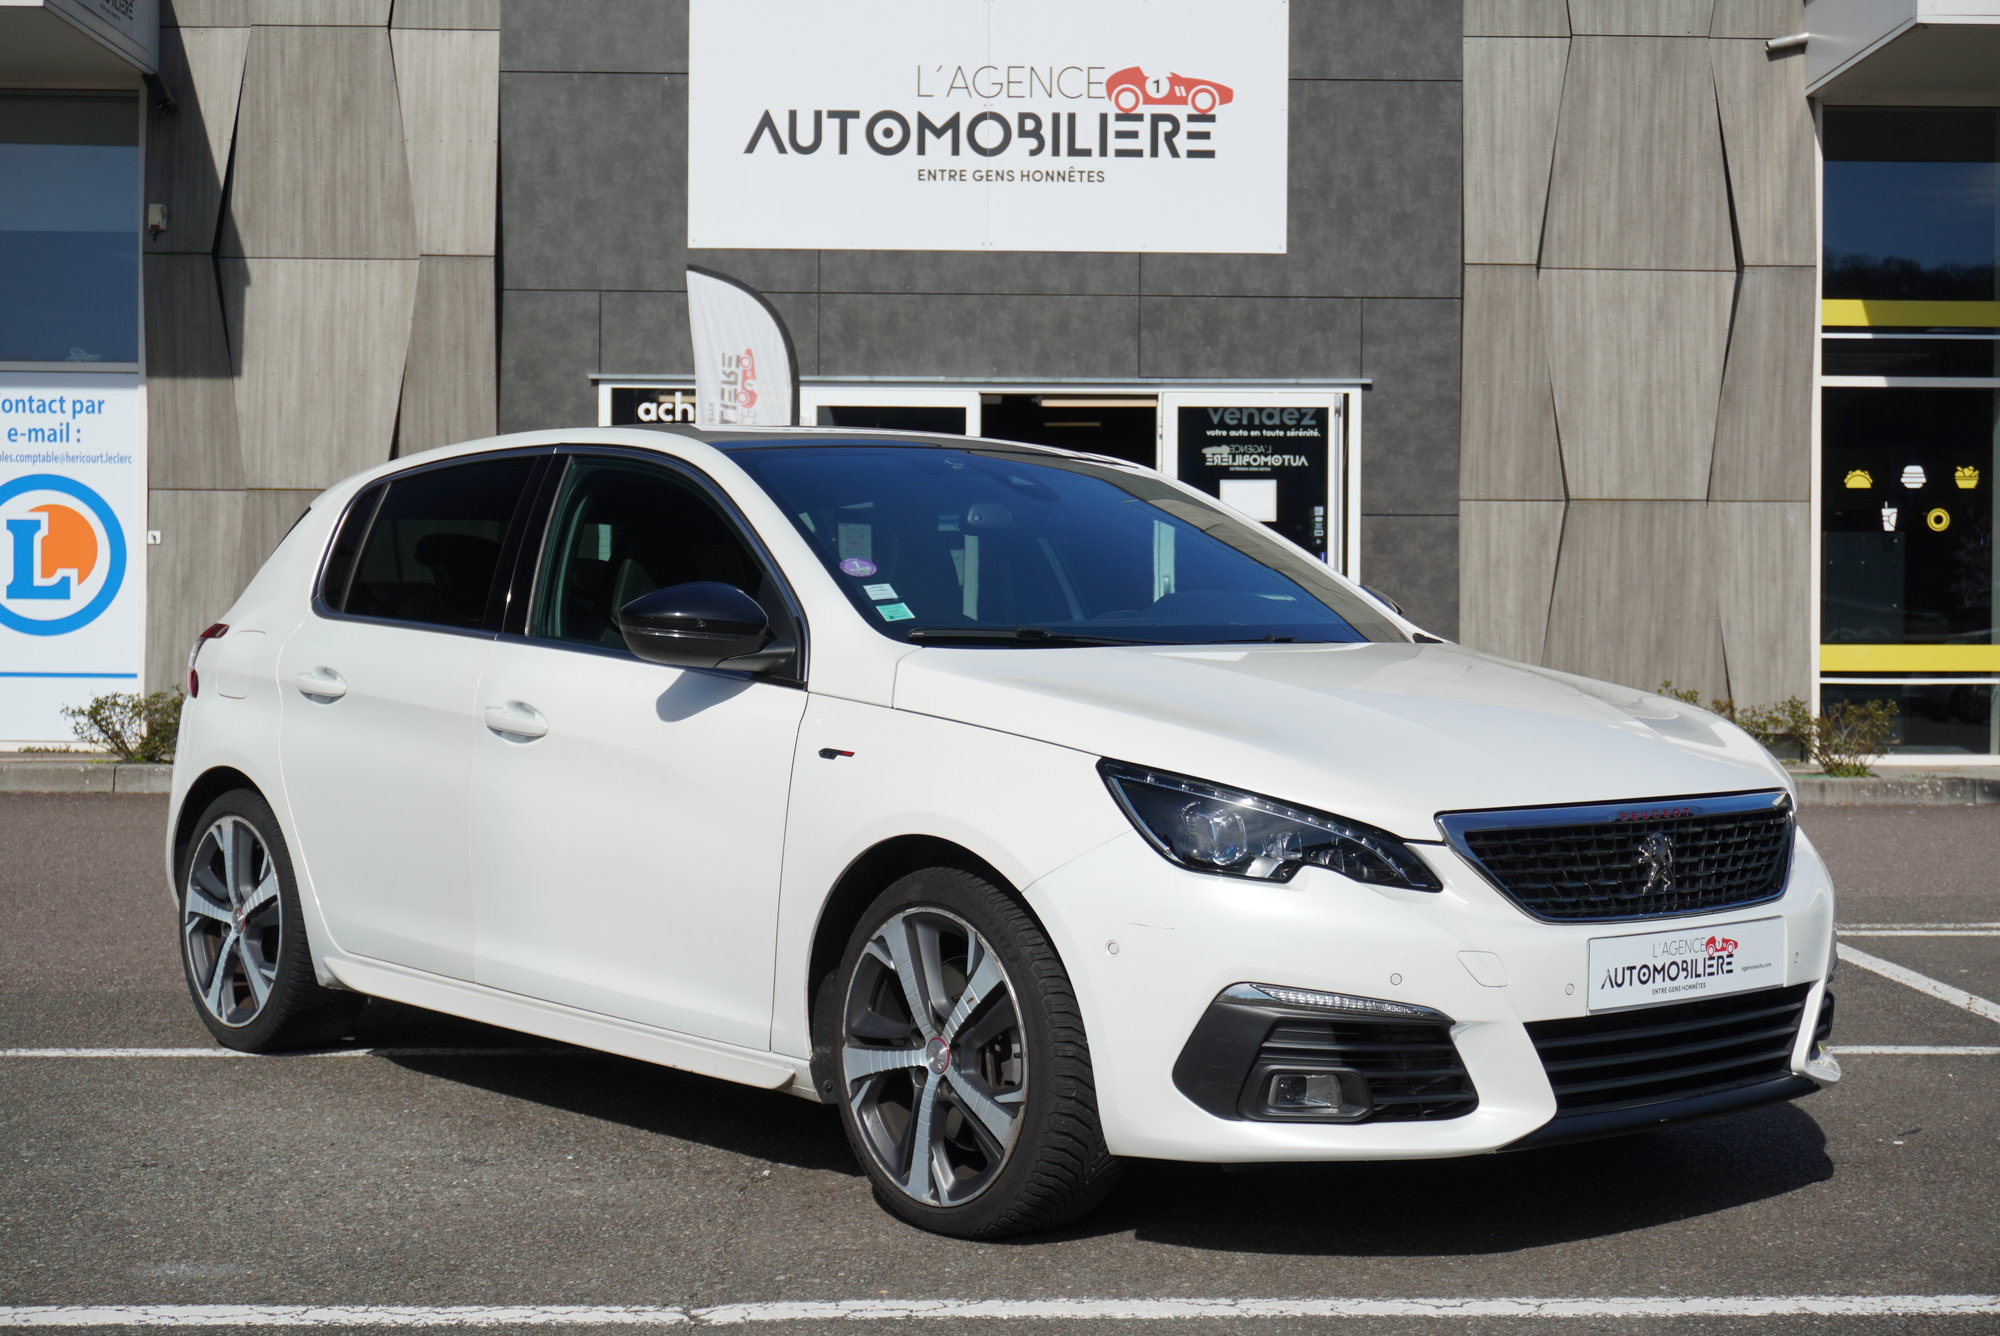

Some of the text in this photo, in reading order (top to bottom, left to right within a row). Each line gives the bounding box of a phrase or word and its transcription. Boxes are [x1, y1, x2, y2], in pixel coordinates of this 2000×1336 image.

[917, 64, 1106, 99] L'AGENCE
[1152, 78, 1161, 94] 1
[743, 108, 1217, 159] AUTOMOBILIERE
[917, 165, 1106, 184] ENTRE GENS HONNÊTES
[0, 394, 105, 419] ontact par
[637, 391, 695, 422] ach
[7, 422, 70, 443] e-mail
[1206, 427, 1320, 437] votre auto en toute sérénité.
[1620, 807, 1690, 821] PEUGEOT
[1652, 936, 1706, 958] L'AGENCE
[1600, 953, 1734, 990] AUTOMOBILIERE
[1652, 982, 1706, 995] ENTRE GENS HONNÊTES
